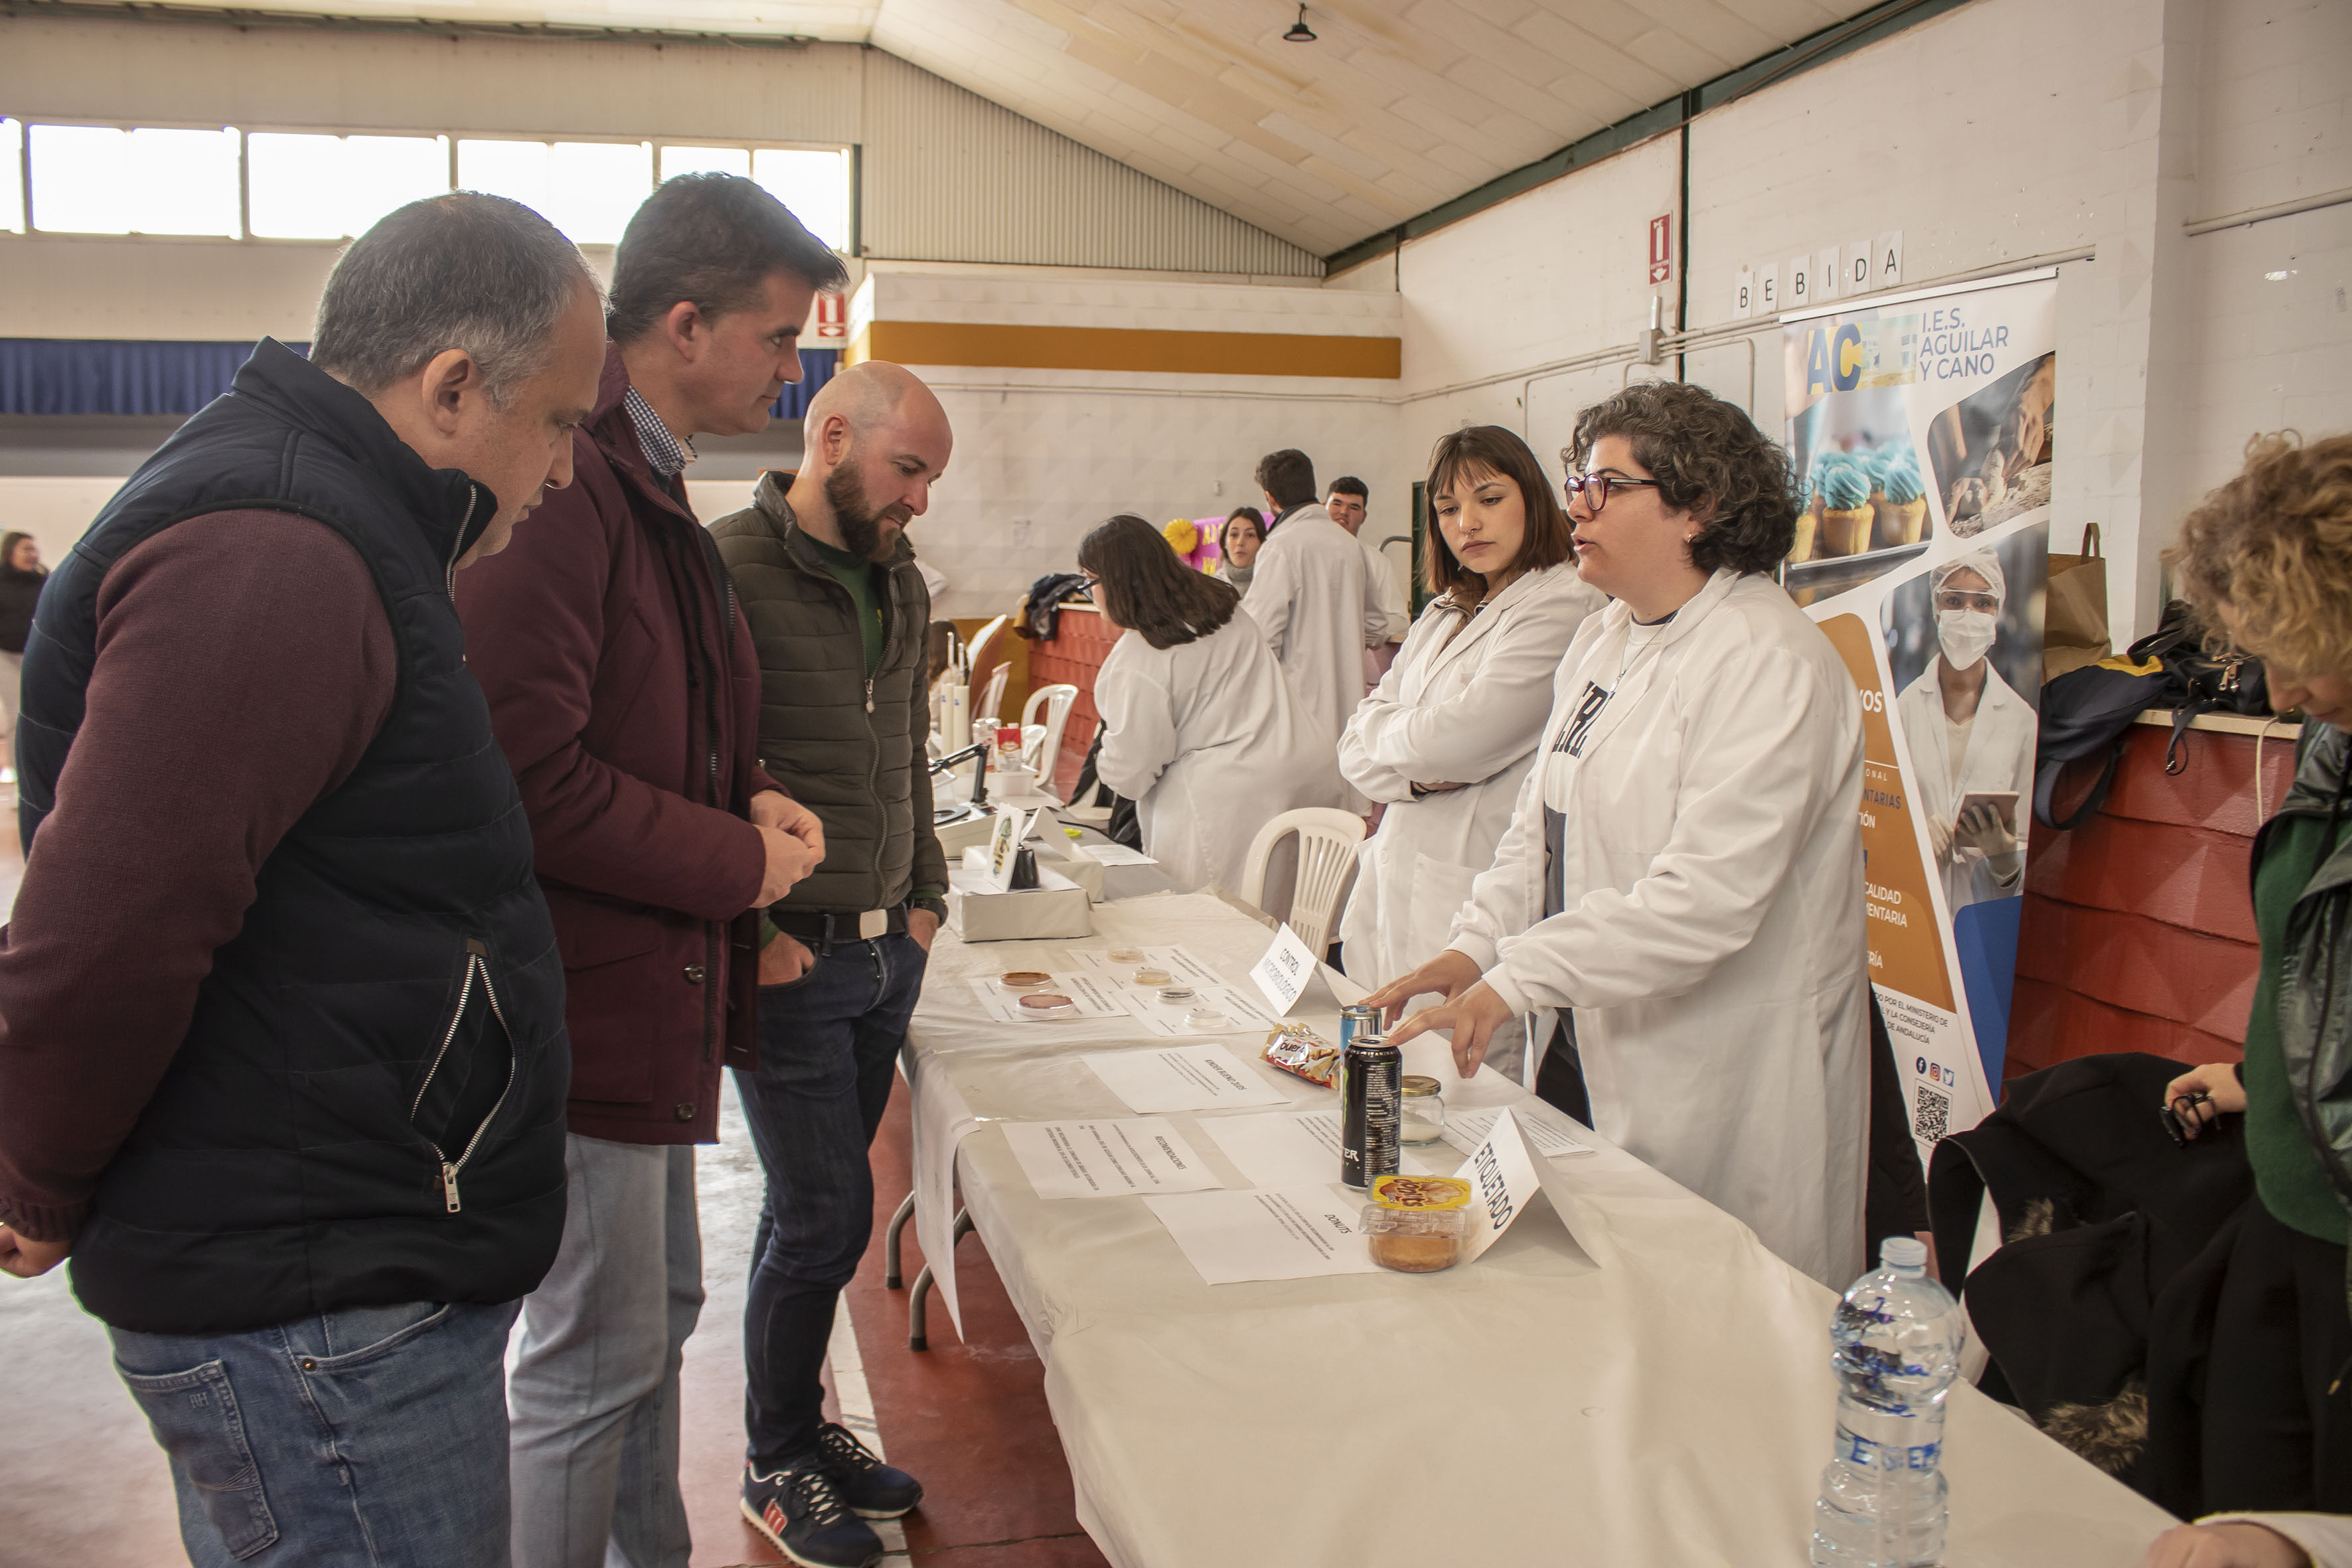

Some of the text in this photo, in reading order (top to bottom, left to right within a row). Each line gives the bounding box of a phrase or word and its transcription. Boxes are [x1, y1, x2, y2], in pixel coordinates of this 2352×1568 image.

[1740, 249, 1897, 309] BEBIDA
[1922, 307, 1965, 333] I.E.S.
[1920, 325, 2009, 358] AGUILAR
[1806, 323, 1863, 395] AC
[1920, 353, 1995, 382] Y CANO
[1858, 810, 1875, 829] IÓN
[1866, 902, 1908, 927] ENTARIA
[1280, 948, 1300, 976] CONTROL
[1885, 996, 1897, 1007] POR
[1898, 1001, 1905, 1010] EL
[1907, 1004, 1939, 1024] MINISTERIO
[1939, 1017, 1949, 1028] DE
[1891, 1010, 1898, 1018] LA
[1215, 1070, 1237, 1082] BUENO
[1154, 1136, 1187, 1170] RECOMENDACIONES
[1475, 1141, 1513, 1230] ETIQUETADO
[1324, 1214, 1353, 1235] DONUTS
